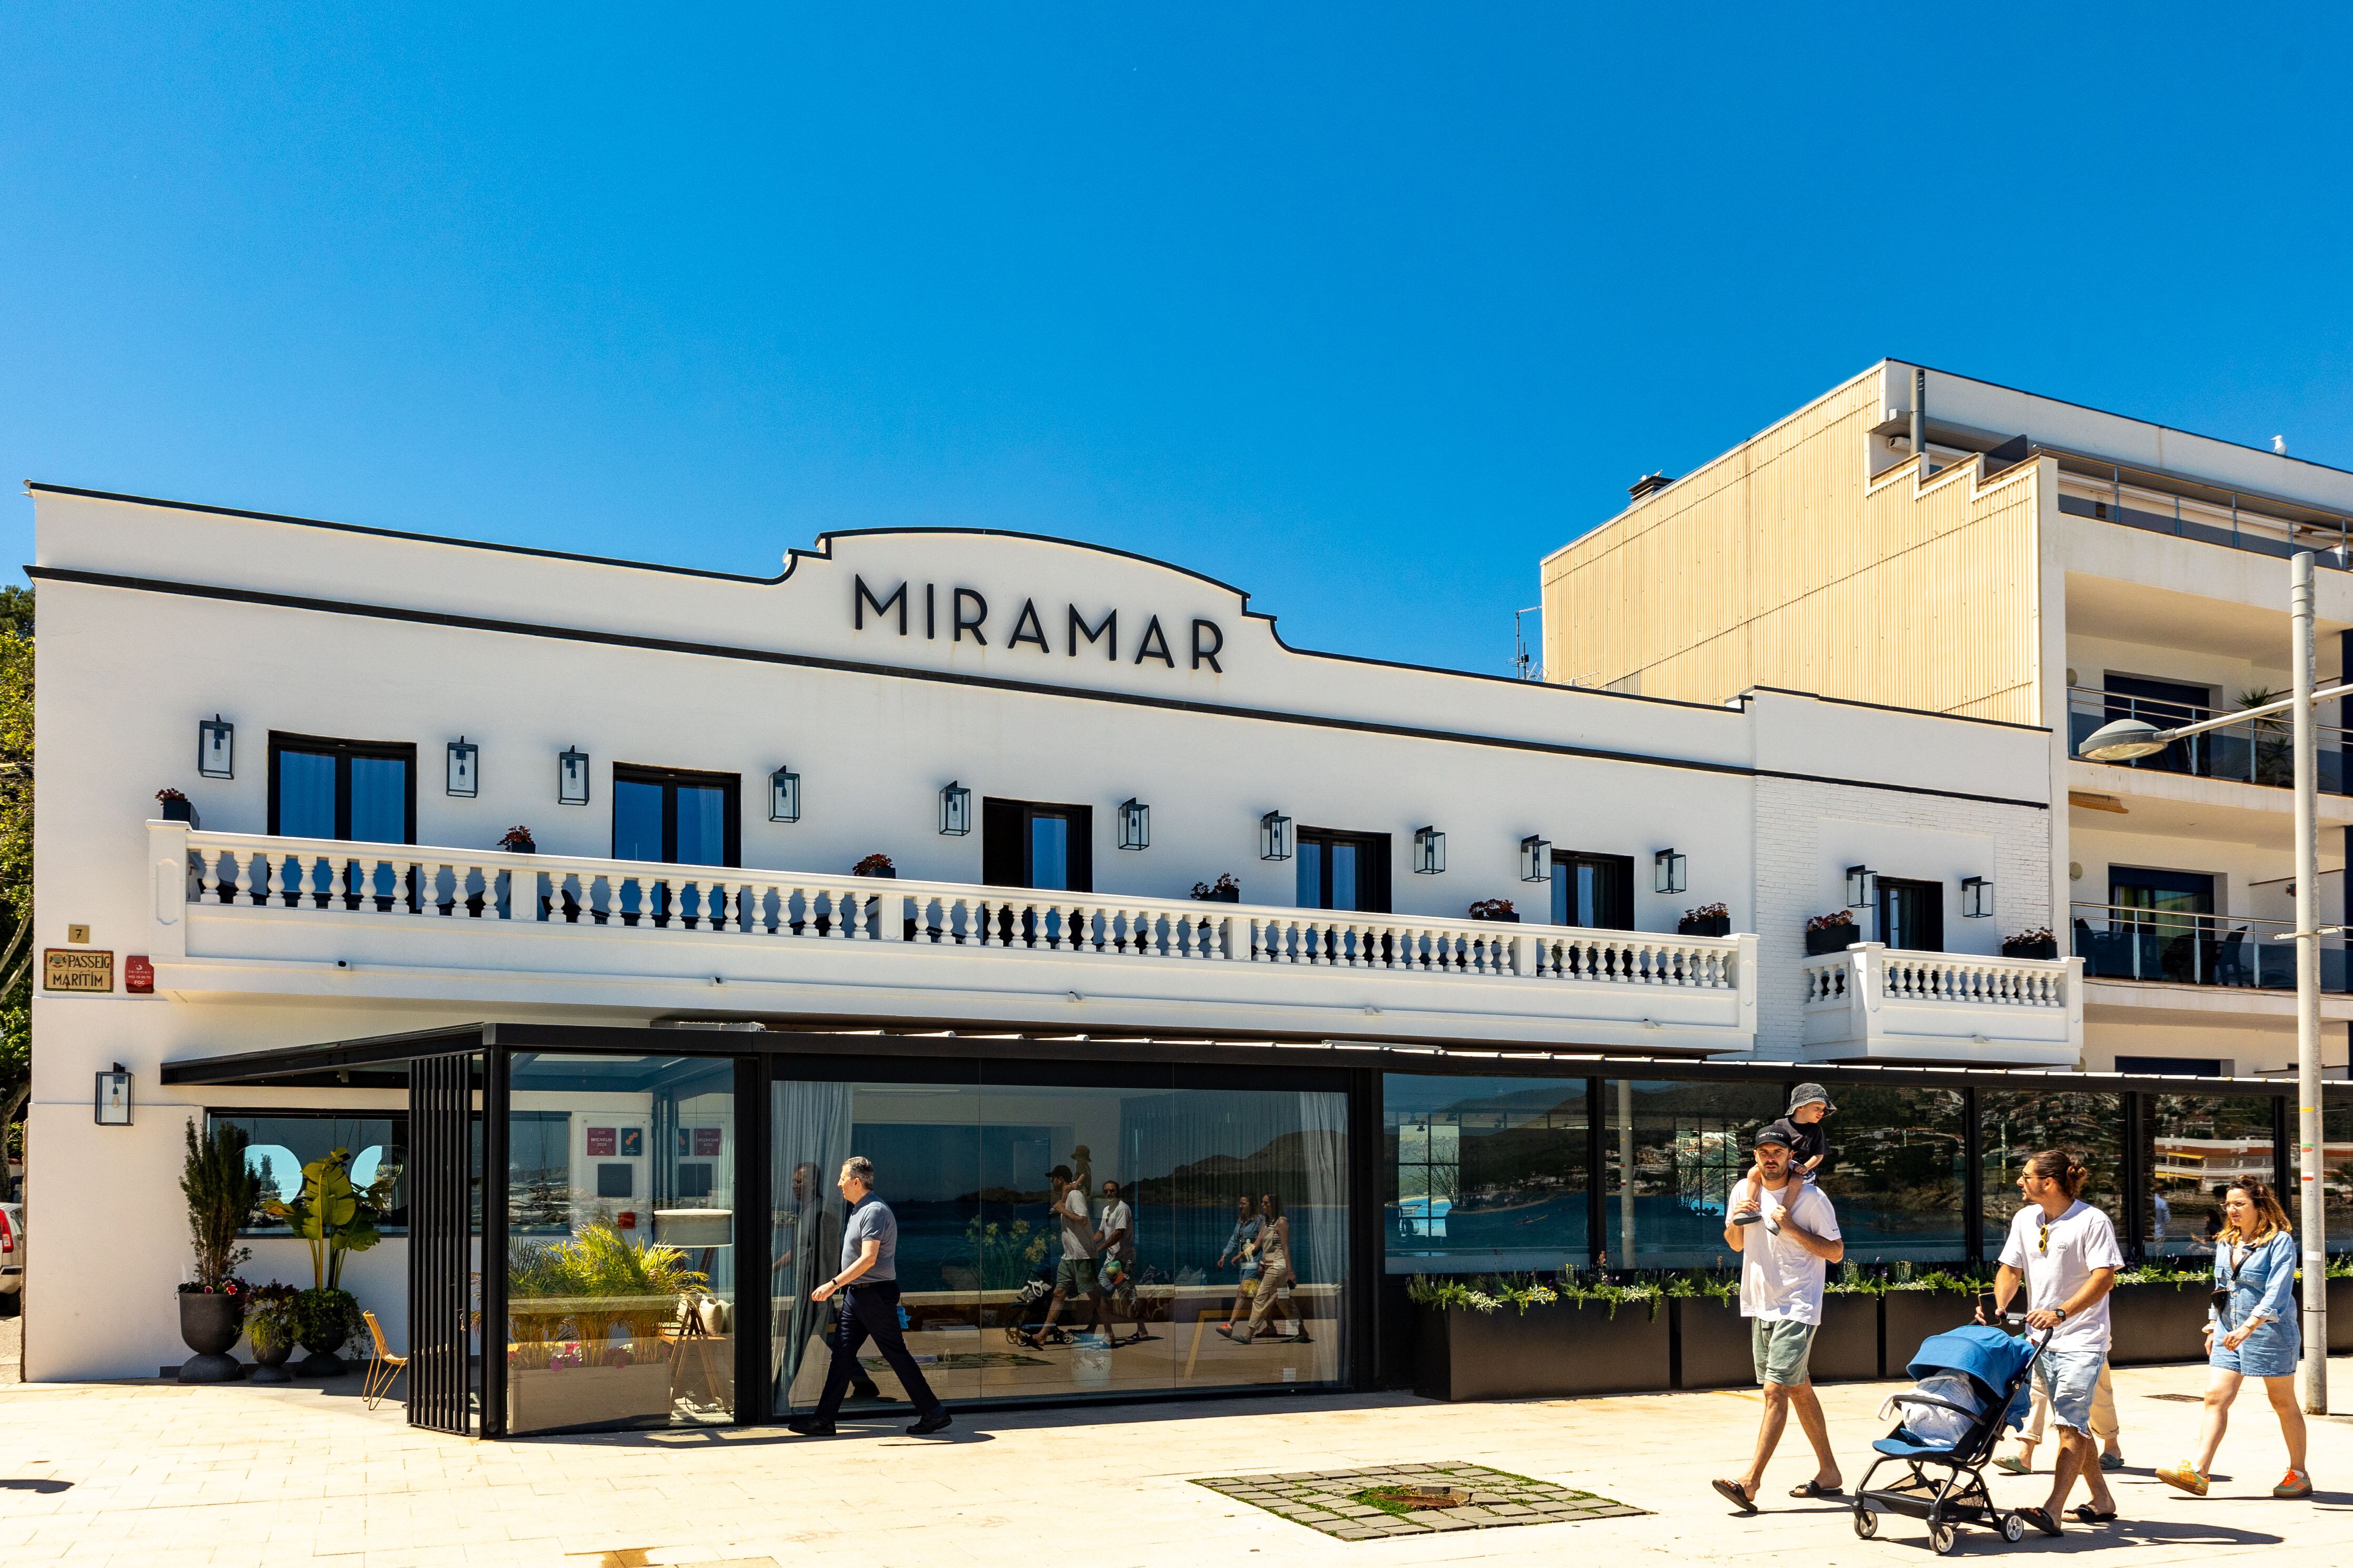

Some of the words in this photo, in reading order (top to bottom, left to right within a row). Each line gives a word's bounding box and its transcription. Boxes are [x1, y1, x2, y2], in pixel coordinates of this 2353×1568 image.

[854, 572, 1224, 674] MIRAMAR
[75, 929, 83, 939] 7
[68, 954, 110, 968] PASSEIG
[53, 971, 103, 987] MARÍTIM
